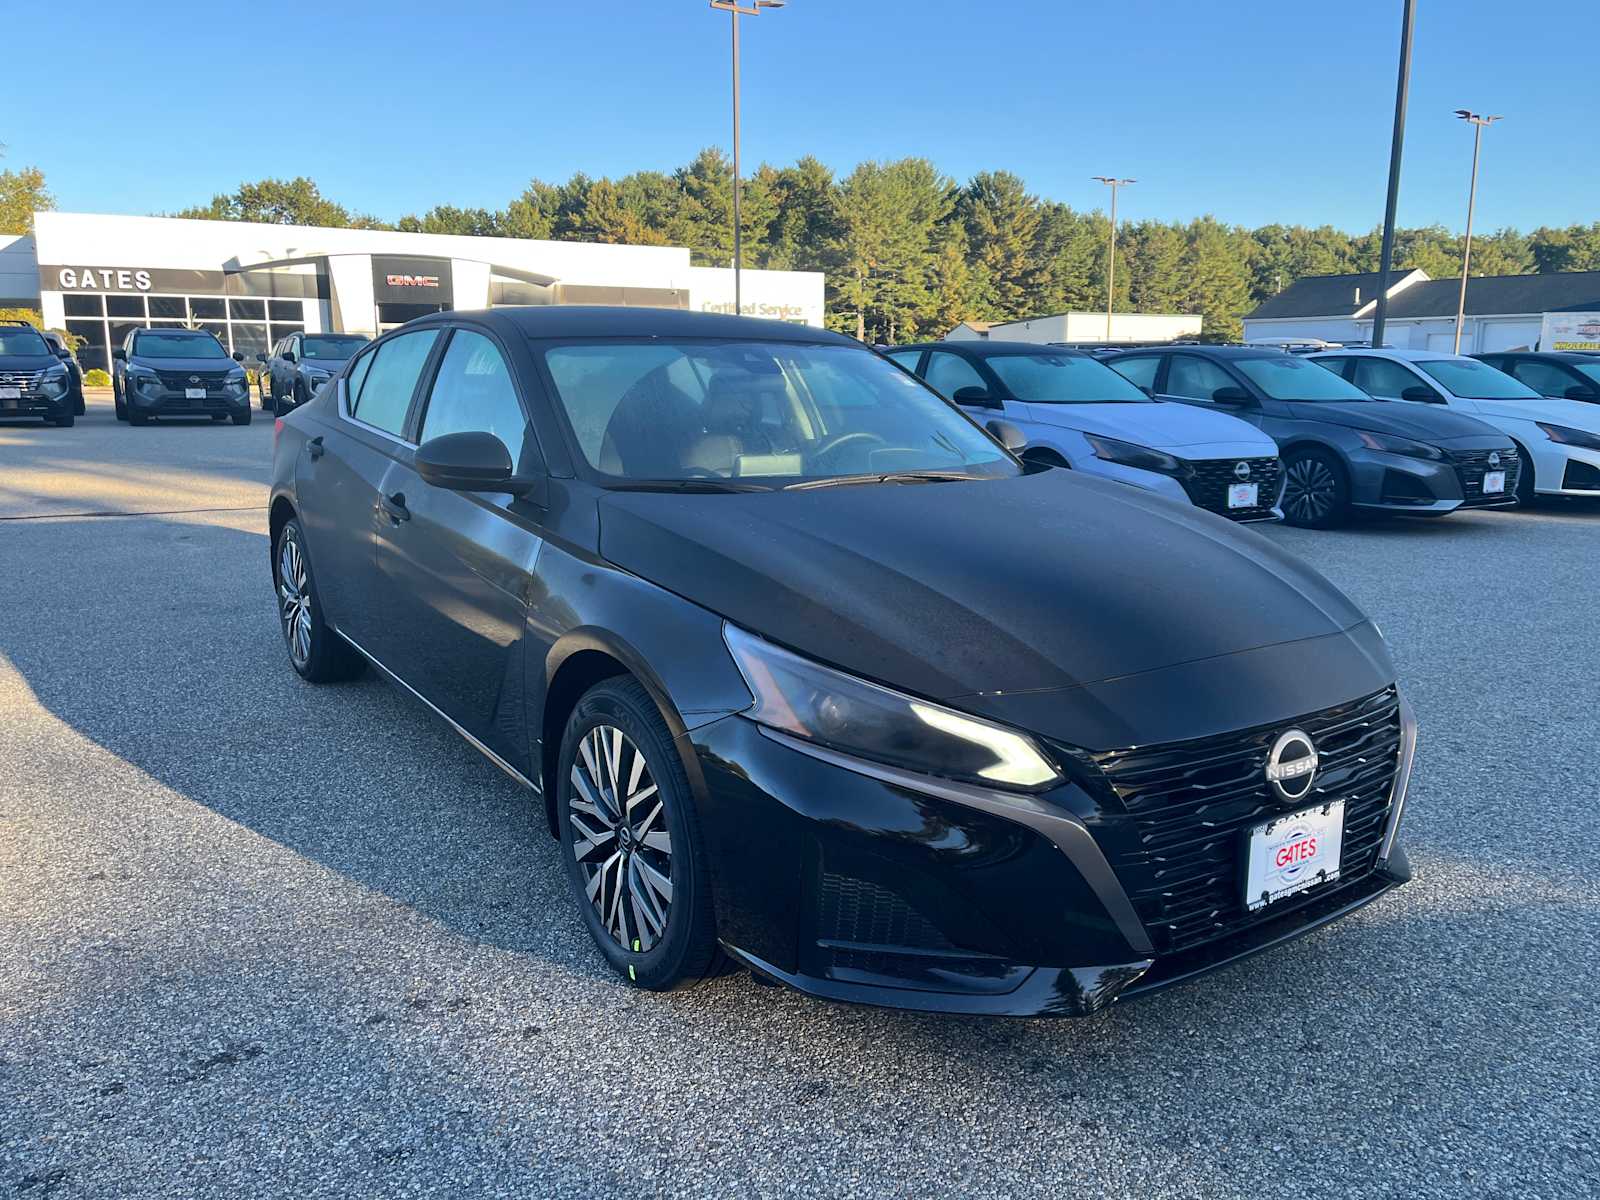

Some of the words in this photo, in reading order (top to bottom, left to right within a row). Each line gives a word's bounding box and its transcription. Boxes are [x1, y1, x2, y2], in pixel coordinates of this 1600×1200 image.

[60, 268, 151, 290] GATES
[386, 274, 439, 287] GMC
[702, 301, 756, 315] Certifed
[1268, 755, 1318, 779] NISSAN
[1276, 838, 1317, 867] GATES
